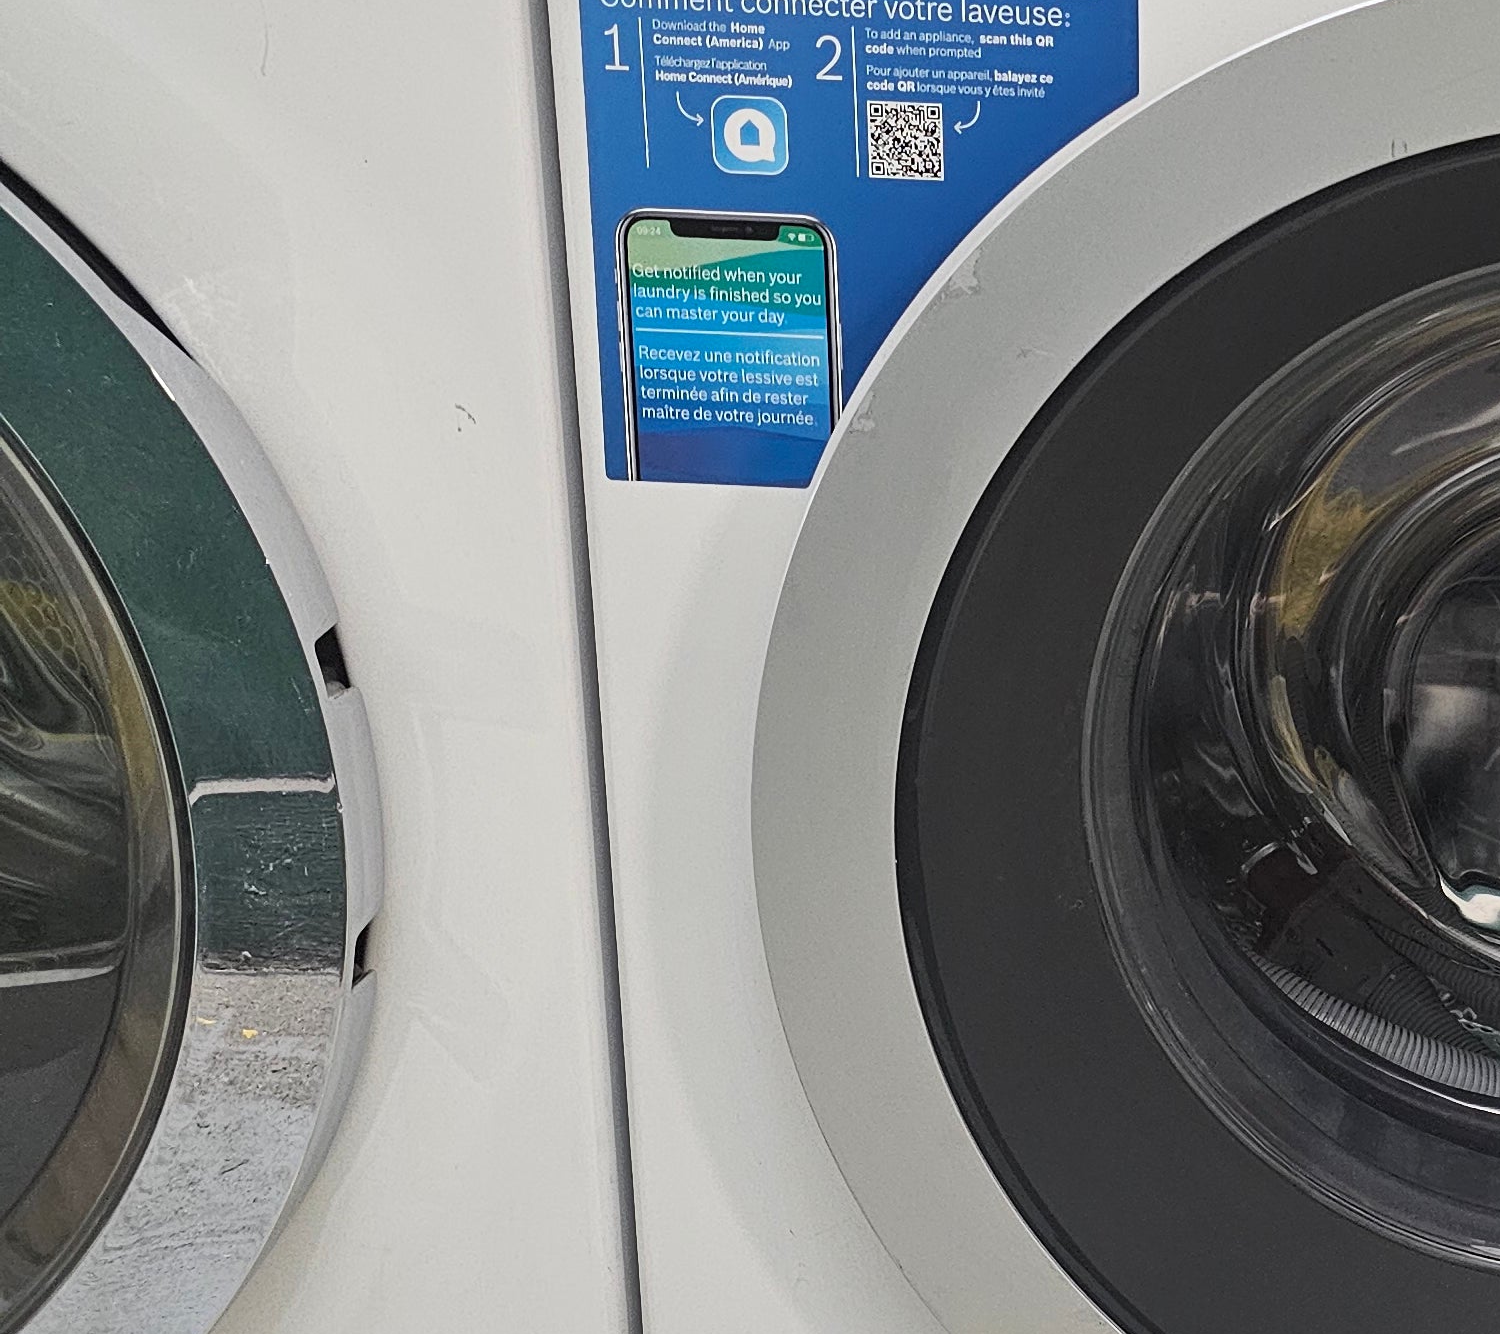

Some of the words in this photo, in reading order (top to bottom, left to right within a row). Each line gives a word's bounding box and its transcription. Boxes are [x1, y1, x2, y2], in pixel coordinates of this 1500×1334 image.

[652, 19, 706, 32] Download
[709, 21, 726, 32] the
[731, 23, 765, 34] Home
[653, 34, 702, 47] Connect
[706, 36, 763, 51] (America)
[768, 39, 790, 51] App
[865, 28, 878, 39] To
[880, 29, 901, 40] add
[903, 31, 917, 41] an
[919, 32, 974, 45] appliance,
[980, 34, 1007, 45] scan
[1010, 35, 1032, 46] this
[1036, 36, 1054, 47] QR
[604, 24, 629, 71] 1
[865, 43, 894, 54] code
[896, 45, 926, 56] when
[928, 47, 982, 59] prompted
[815, 34, 843, 81] 2
[655, 70, 686, 82] Home
[689, 72, 732, 84] Connect
[734, 73, 793, 88] (Amérique)
[866, 65, 890, 76] Pour
[893, 66, 930, 79] ajouter
[932, 69, 945, 78] un
[947, 69, 993, 83] appareil,
[994, 71, 1037, 84] balayez
[1040, 74, 1054, 84] ce
[866, 80, 895, 91] code
[897, 81, 915, 92] QR
[917, 82, 956, 95] lorsque
[958, 85, 983, 95] vous
[984, 86, 991, 97] y
[1017, 84, 1045, 98] invité
[632, 264, 660, 279] Get
[664, 266, 720, 282] notified
[724, 269, 765, 283] when
[769, 272, 802, 286] your
[634, 284, 690, 303] laundry
[694, 285, 706, 300] is
[710, 286, 769, 303] finished
[773, 291, 791, 304] so
[794, 294, 822, 308] you
[636, 307, 662, 319] can
[666, 308, 718, 321] master
[721, 311, 755, 326] your
[639, 345, 700, 361] Recevez
[705, 350, 732, 363] une
[735, 350, 820, 367] notification
[639, 365, 696, 383] lorsque
[699, 370, 738, 384] votre
[742, 371, 792, 386] lessive
[795, 374, 818, 387] est
[641, 385, 707, 401] terminée
[711, 388, 739, 403] afin
[743, 388, 761, 404] de
[765, 392, 808, 406] rester
[642, 406, 690, 420] maître
[693, 407, 711, 421] de
[715, 408, 754, 423] votre
